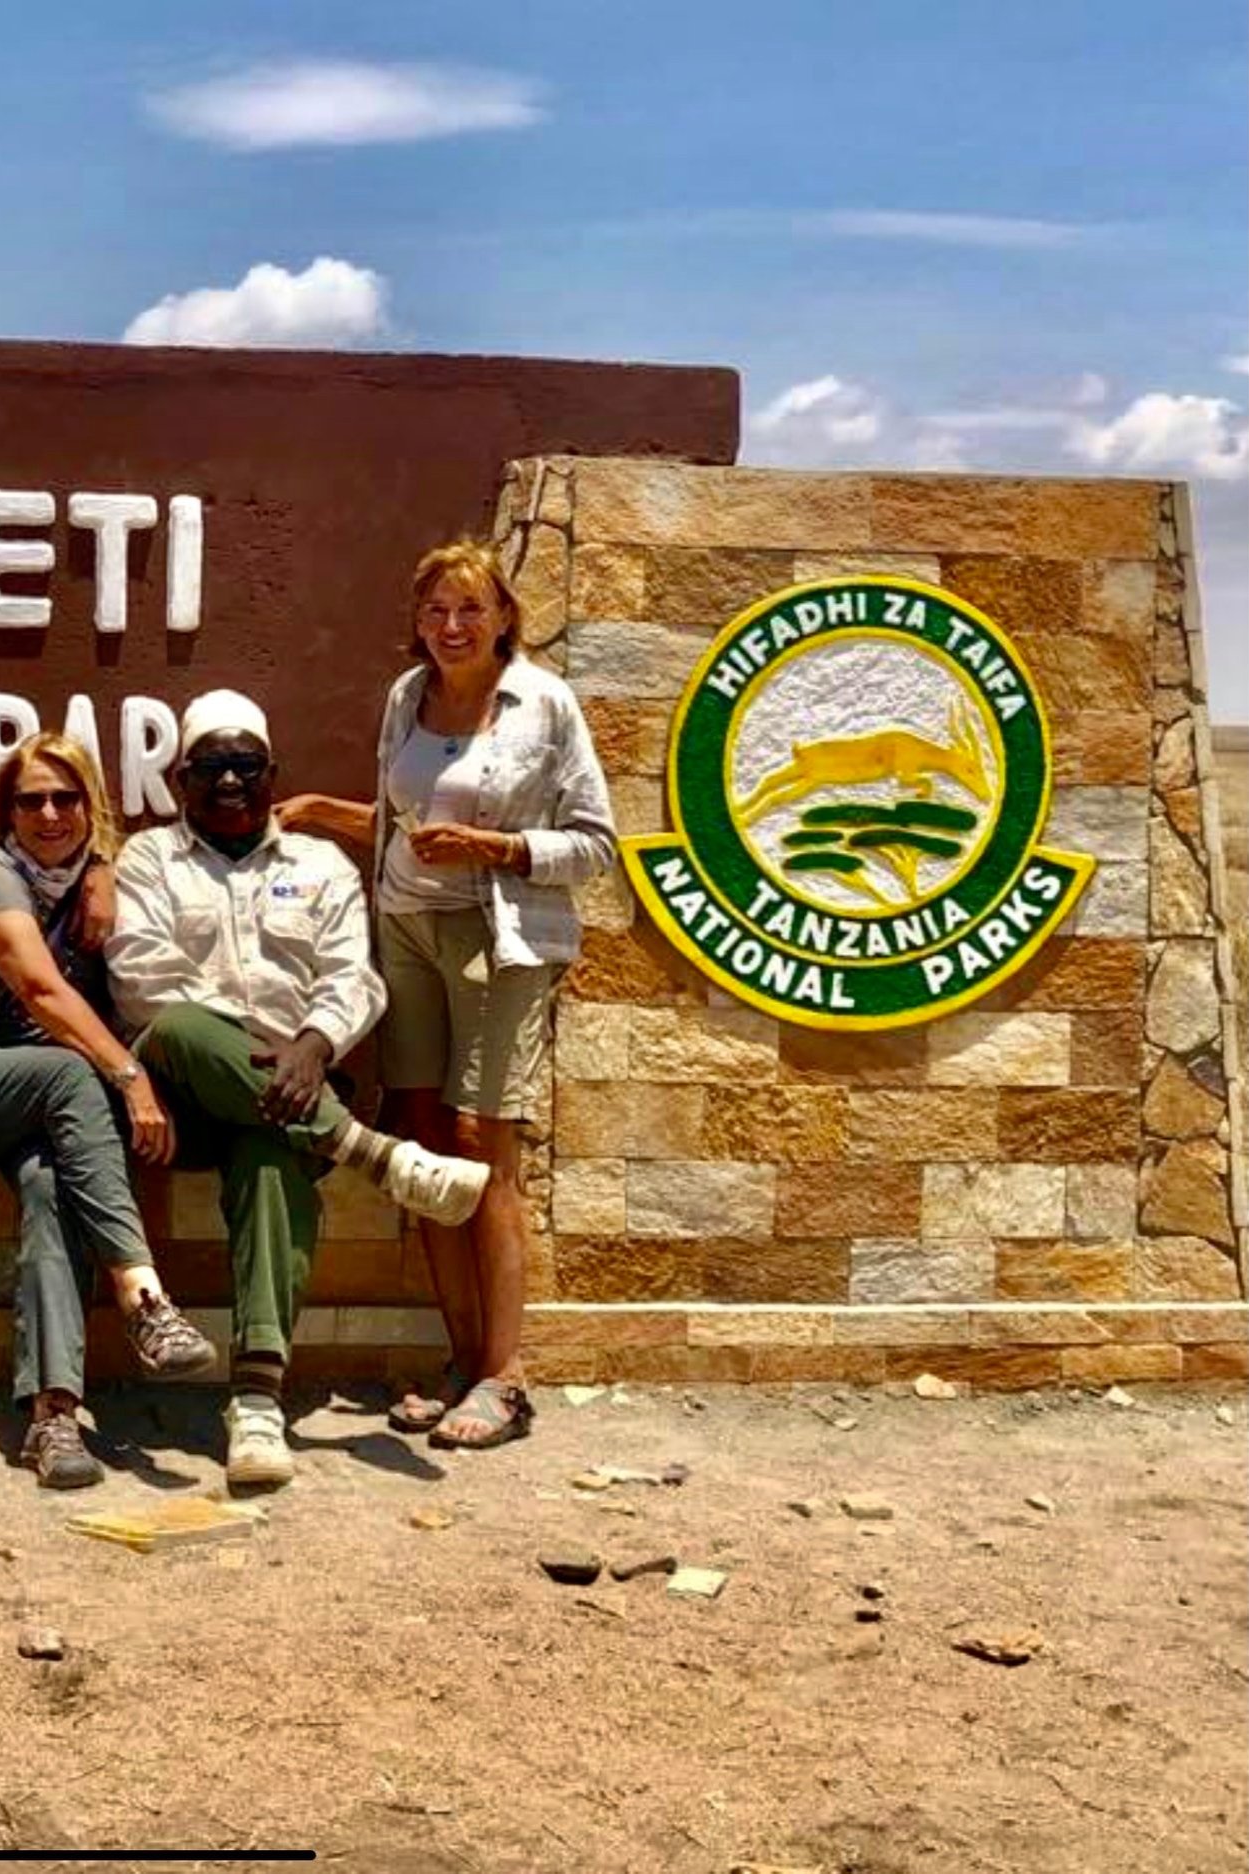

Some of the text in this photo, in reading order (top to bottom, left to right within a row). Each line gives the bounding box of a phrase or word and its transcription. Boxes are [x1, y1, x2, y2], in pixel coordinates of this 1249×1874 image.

[707, 592, 1029, 723] HIFADHI ZA TAIFA
[652, 857, 1061, 1008] NATIONAL PARKS
[745, 880, 972, 957] TANZANIA
